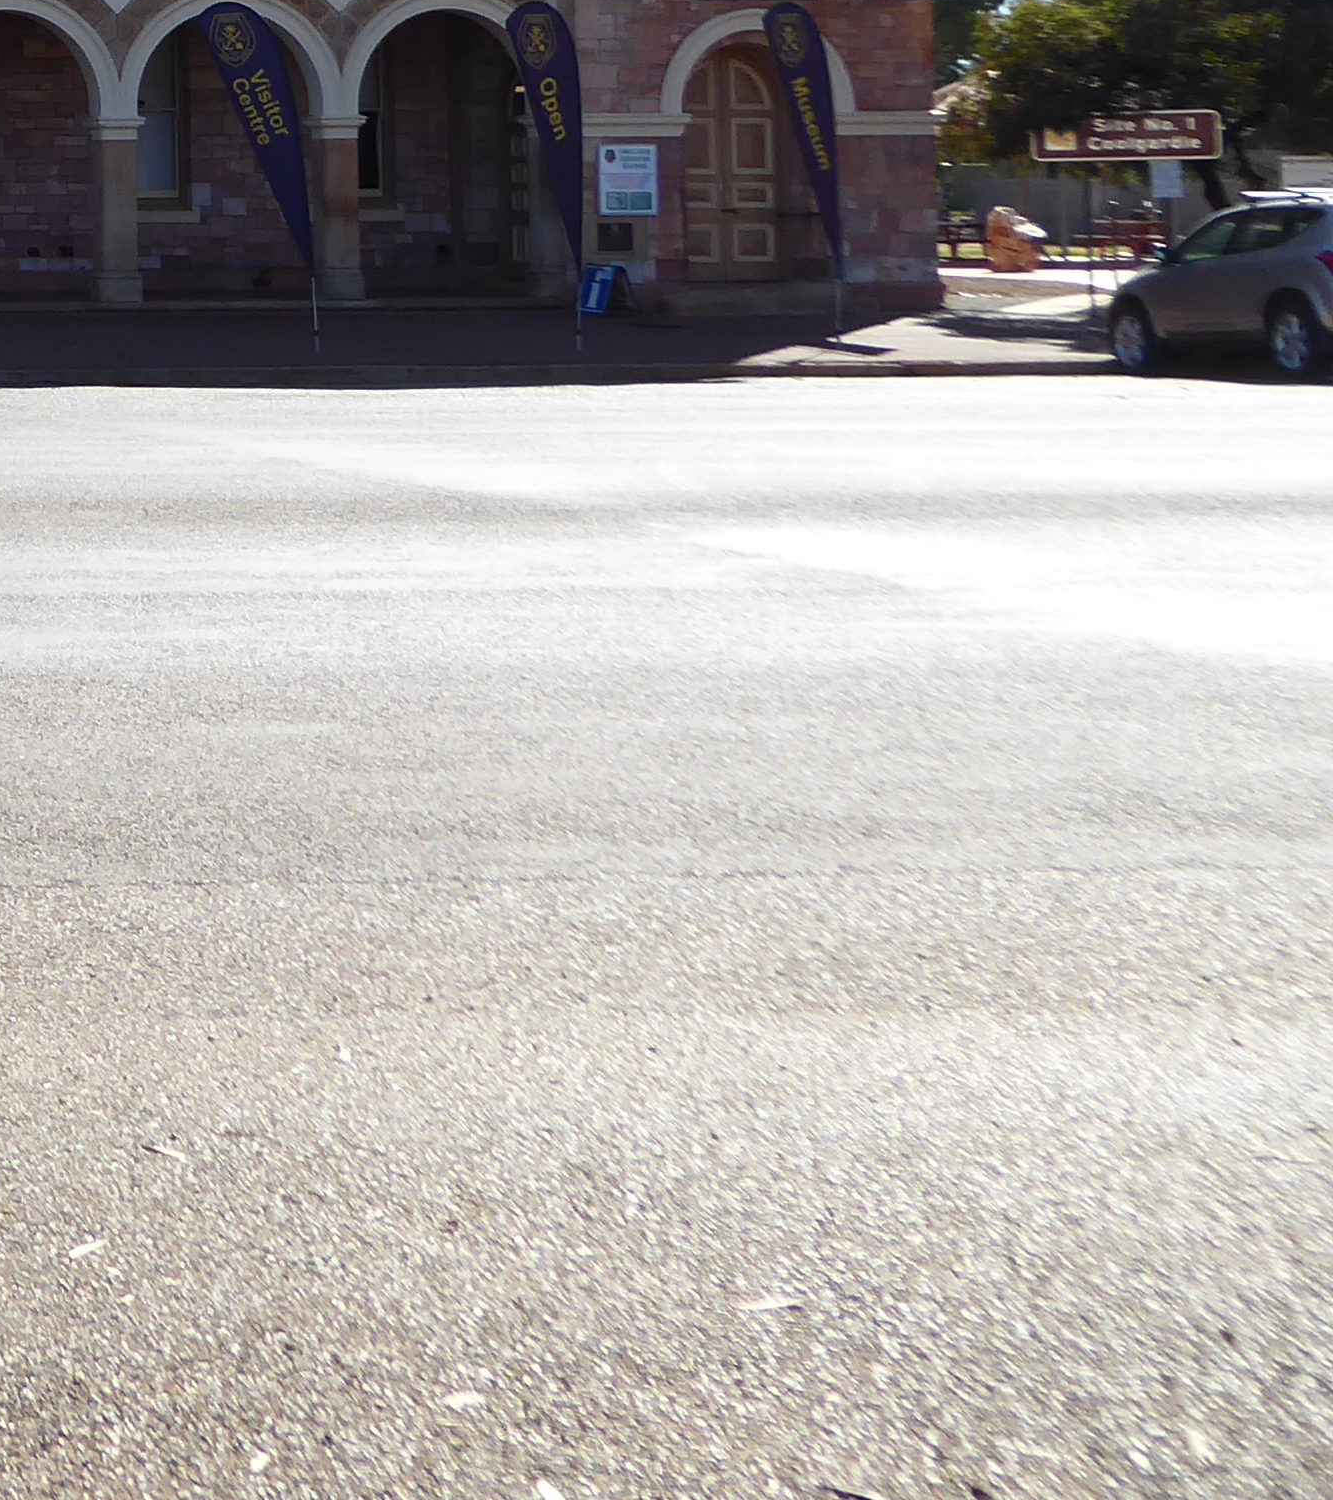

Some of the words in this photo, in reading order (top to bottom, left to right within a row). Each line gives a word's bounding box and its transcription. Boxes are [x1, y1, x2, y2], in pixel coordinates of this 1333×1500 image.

[233, 78, 270, 146] Centre
[250, 68, 290, 135] Visitor
[540, 77, 566, 141] Open
[789, 77, 831, 172] Museum
[1092, 117, 1137, 132] Site
[1086, 135, 1203, 154] Coolgardie
